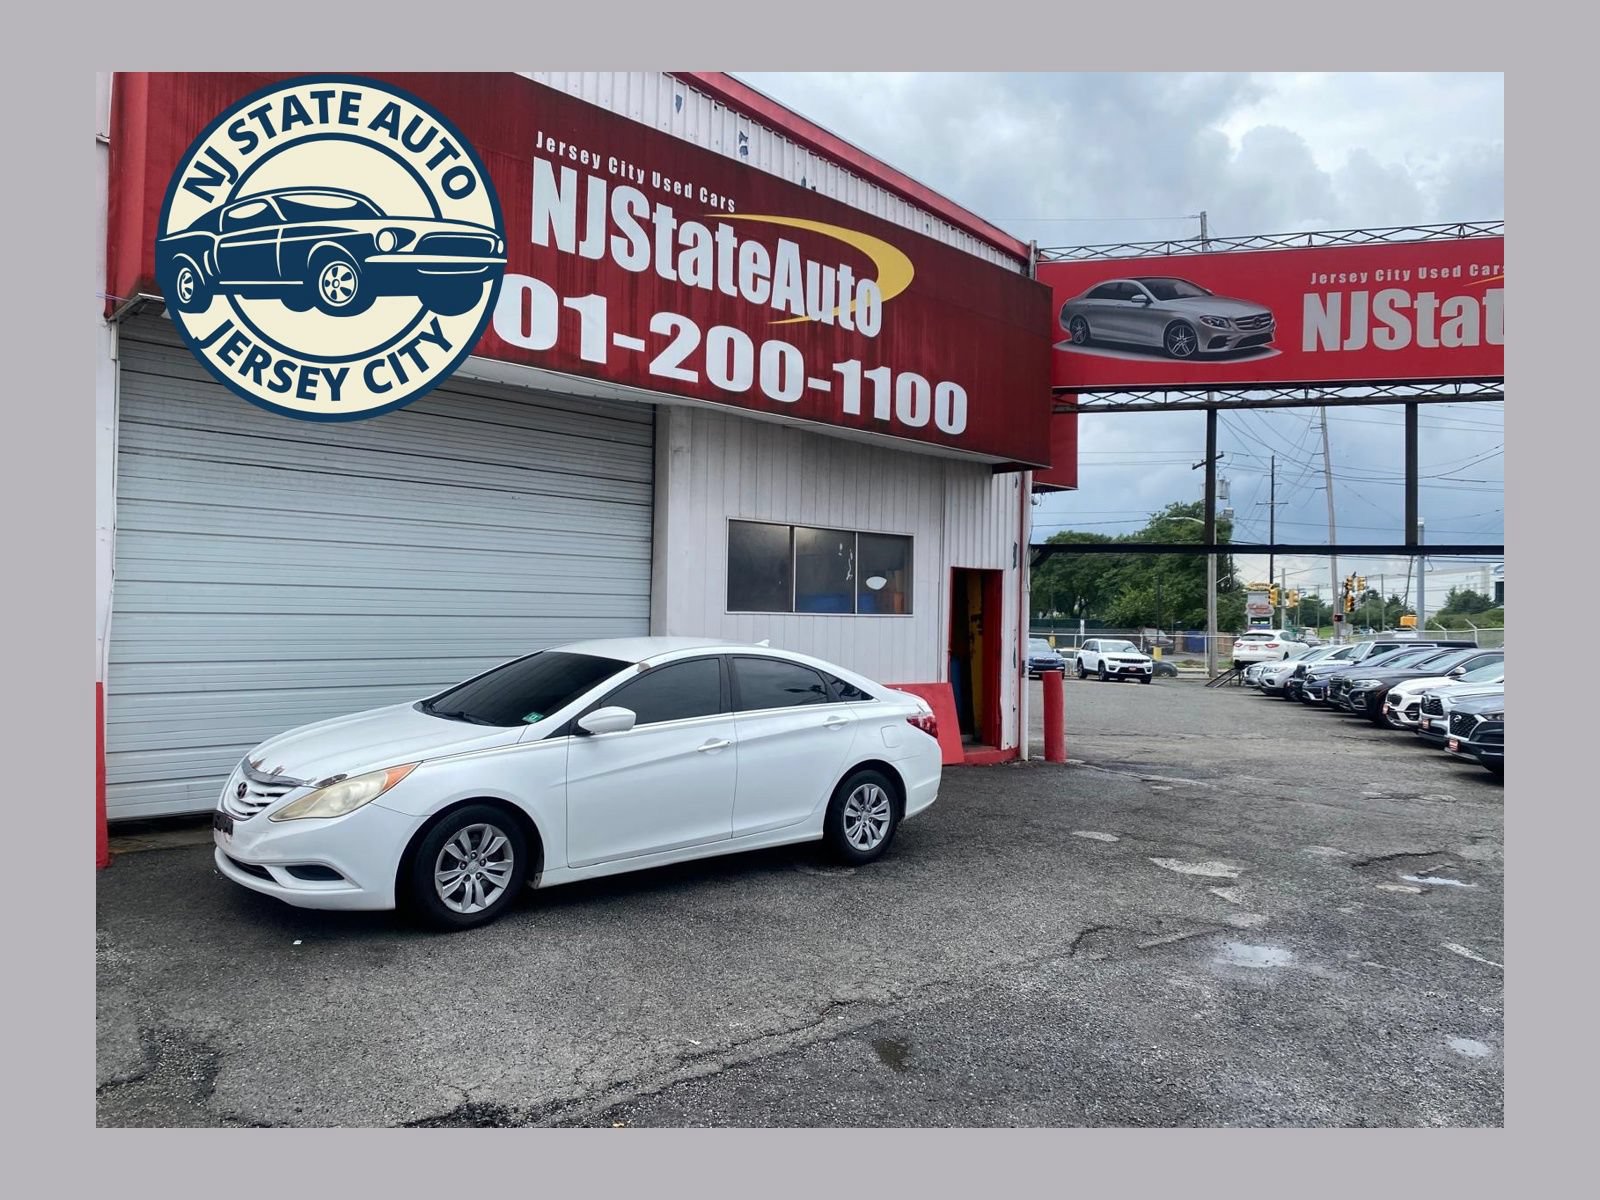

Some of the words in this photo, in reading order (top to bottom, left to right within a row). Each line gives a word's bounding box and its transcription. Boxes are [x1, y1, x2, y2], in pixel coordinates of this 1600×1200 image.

[536, 130, 601, 170] Jersey
[608, 156, 645, 185] City
[652, 171, 693, 199] Used
[700, 186, 736, 213] Cars
[531, 156, 883, 338] NJStateAuto
[1310, 272, 1369, 285] Jersey
[1375, 269, 1411, 283] City
[1418, 265, 1462, 280] Used
[481, 273, 968, 435] 01-200-1100
